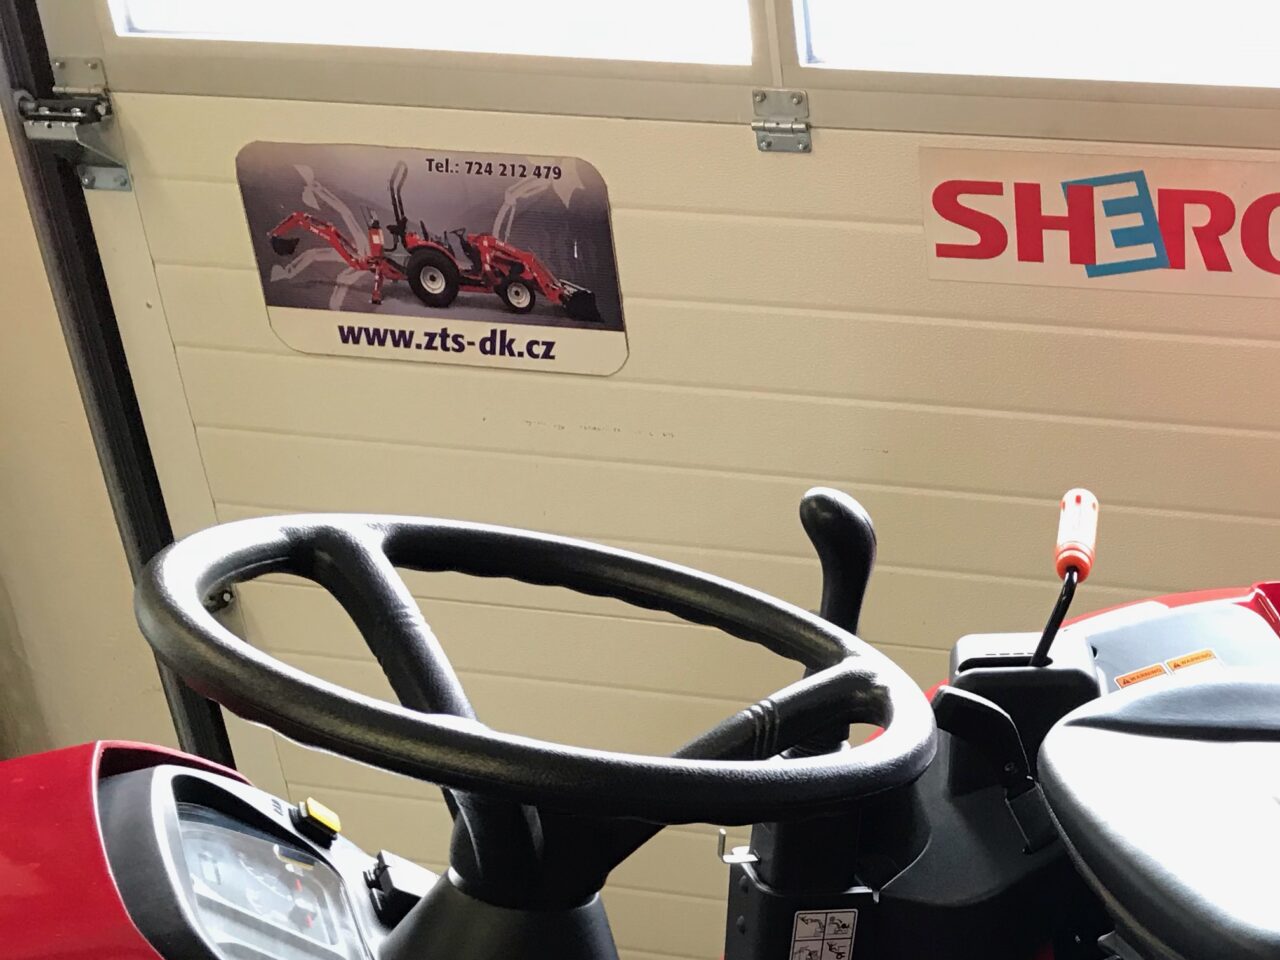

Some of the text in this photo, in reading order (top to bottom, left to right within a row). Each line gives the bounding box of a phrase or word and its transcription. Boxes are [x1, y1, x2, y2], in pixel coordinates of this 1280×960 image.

[425, 158, 562, 180] Tel.: 724 212 479
[337, 324, 556, 361] www.zts-dk.cz
